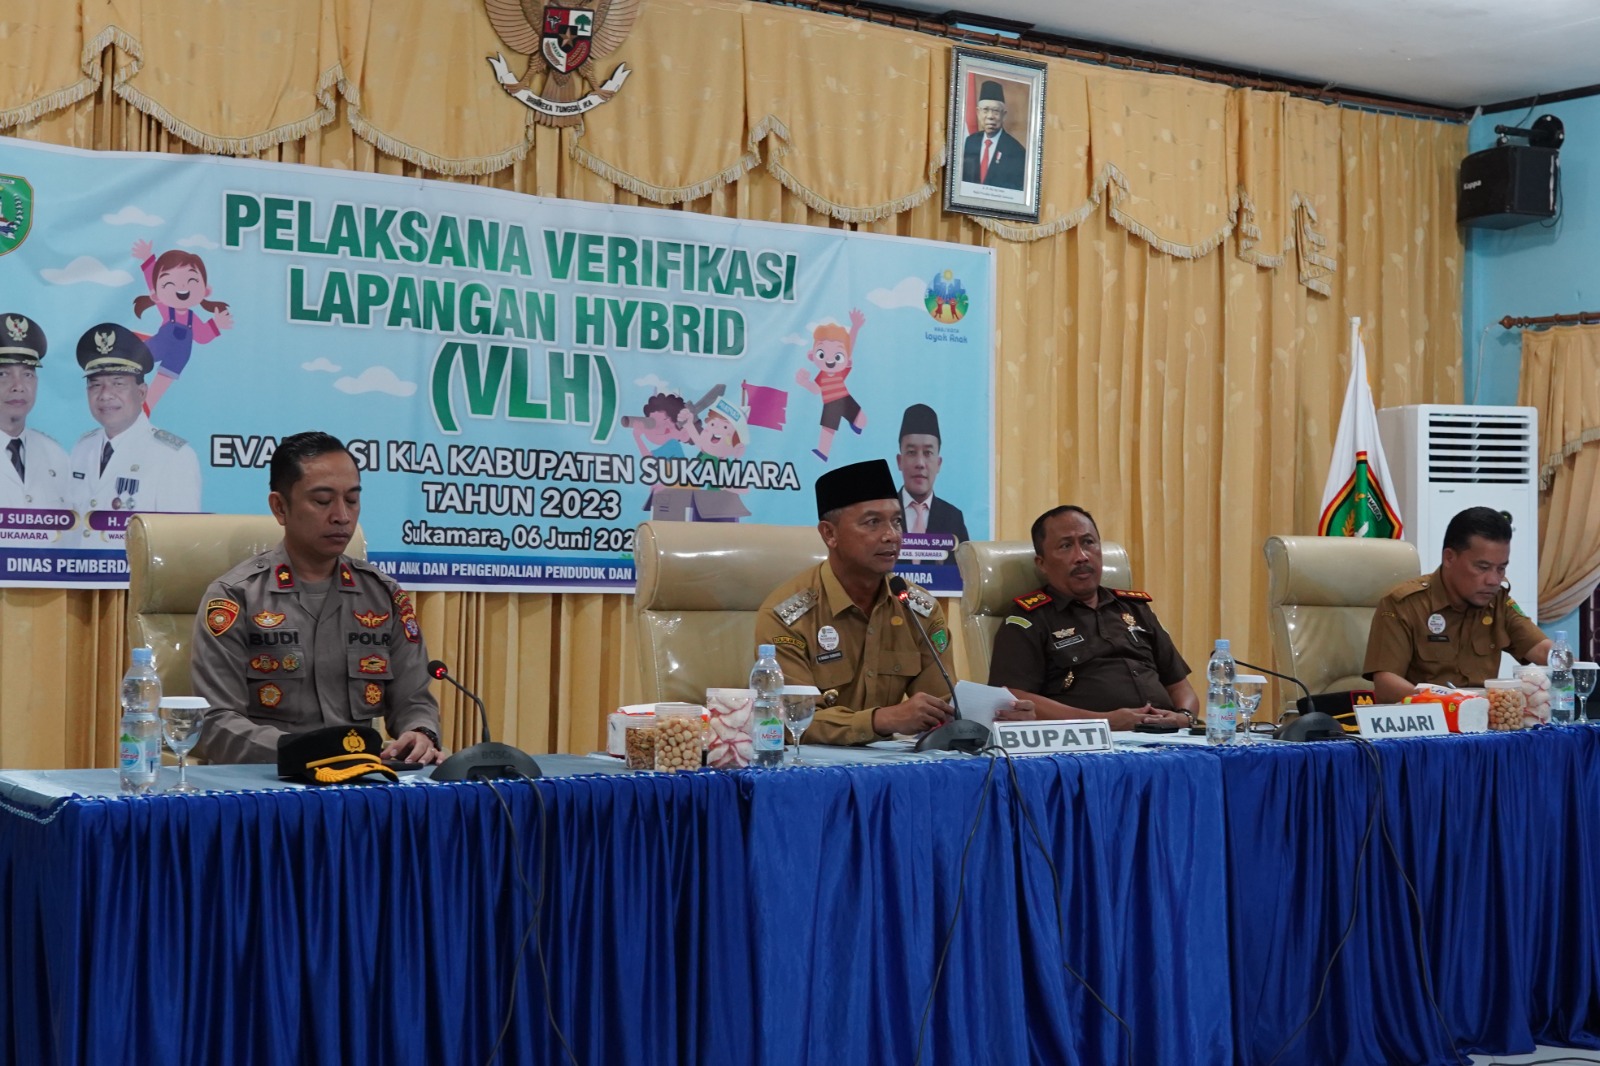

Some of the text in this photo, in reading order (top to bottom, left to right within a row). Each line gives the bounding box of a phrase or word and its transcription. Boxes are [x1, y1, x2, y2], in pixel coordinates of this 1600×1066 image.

[582, 99, 594, 109] IKA
[224, 192, 798, 301] PELAKSANA VERIFIKASI
[289, 267, 746, 356] LAPANGAN HYBRID
[431, 340, 617, 442] (VLH)
[211, 435, 800, 490] EVASI KLA KABUPATEN SUKAMARA
[422, 482, 621, 520] TAHUN 2023
[7, 513, 70, 526] SUBAGIO
[402, 520, 635, 550] Sukamara, 06 Juni 202
[7, 558, 52, 573] DINAS
[399, 562, 420, 575] ANAK
[423, 562, 448, 575] DAN
[452, 563, 541, 578] PENGENDALIAN
[545, 565, 605, 580] PENDUDUK
[609, 567, 632, 580] DAN
[249, 632, 299, 646] BUDI
[1371, 715, 1434, 733] KAJARI
[1000, 727, 1108, 748] BUPATI
